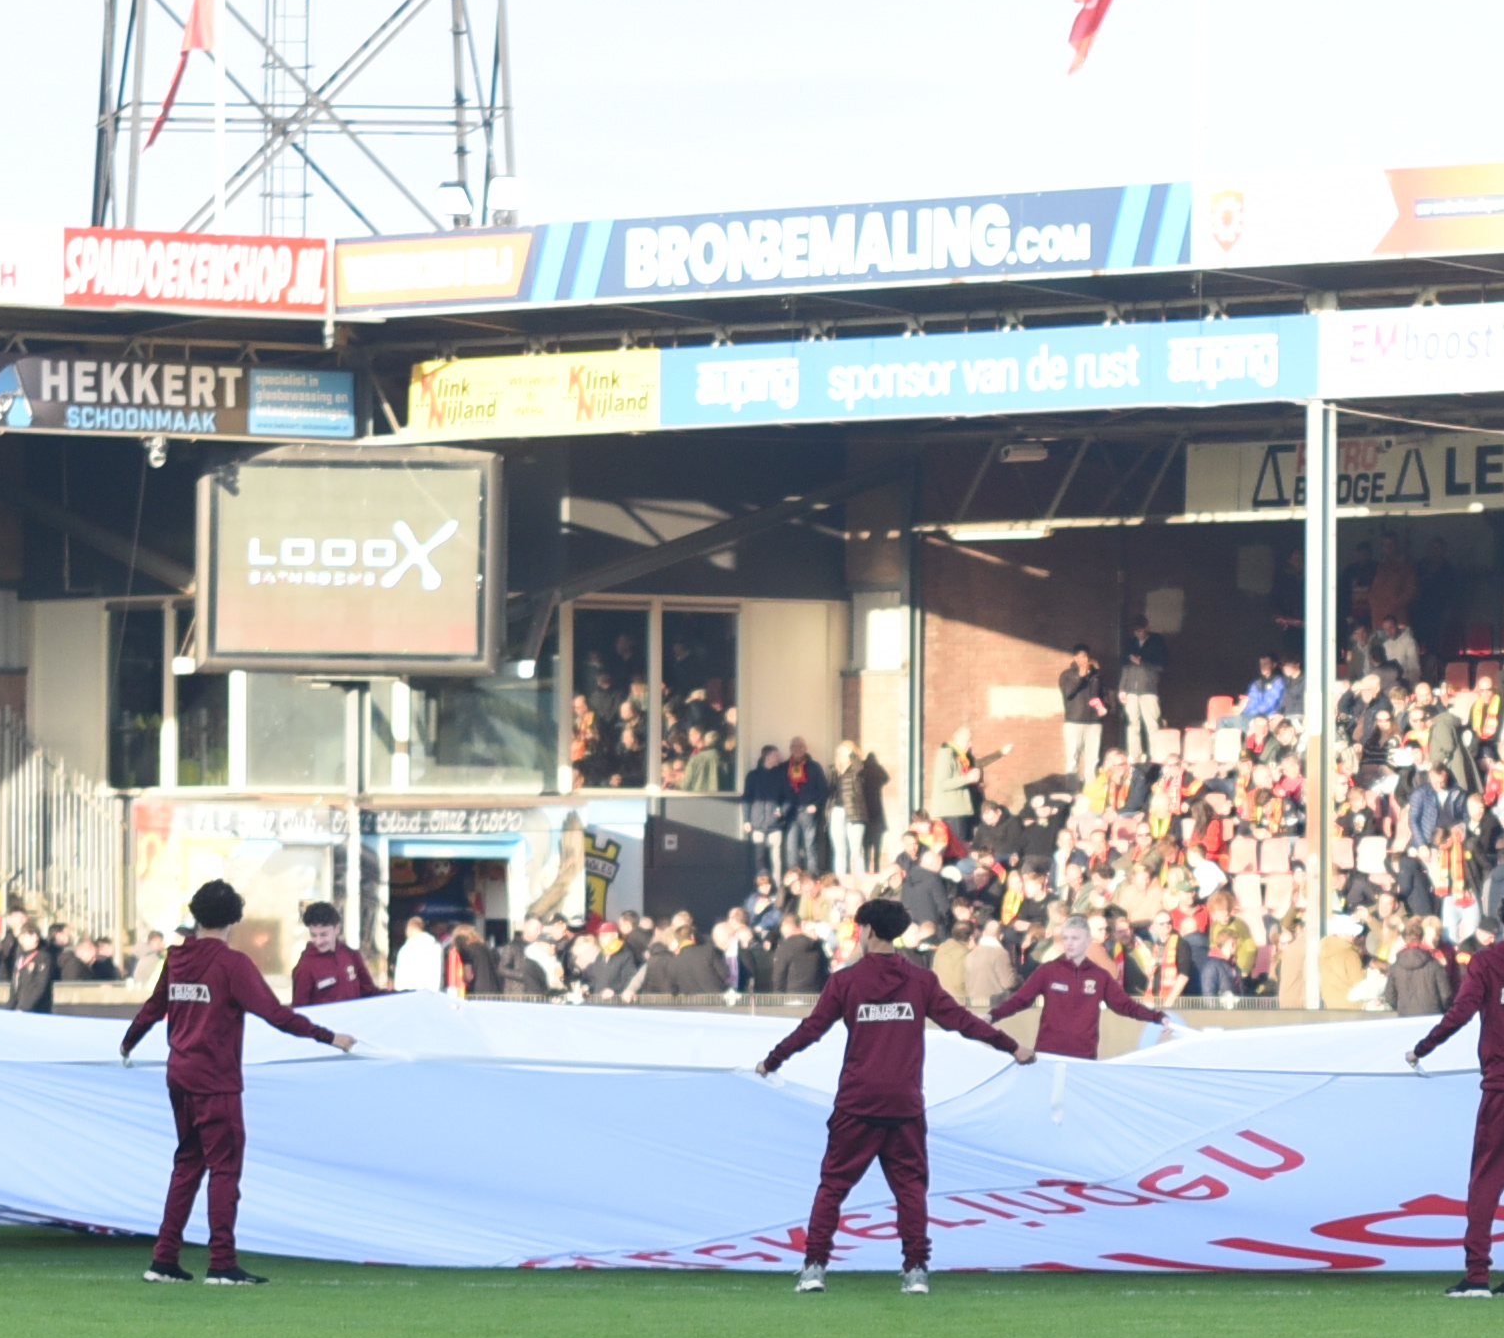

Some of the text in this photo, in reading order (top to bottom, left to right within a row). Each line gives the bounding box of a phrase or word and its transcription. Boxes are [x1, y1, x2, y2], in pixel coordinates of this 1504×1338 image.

[65, 236, 327, 305] SPANDOEKENSHOP.NL
[41, 358, 244, 408] HEKKERT
[568, 365, 621, 394] Klink
[696, 336, 1279, 412] auping sponsor van de rust auping
[65, 404, 218, 433] SCHOONMAAK
[576, 392, 649, 422] Nijland
